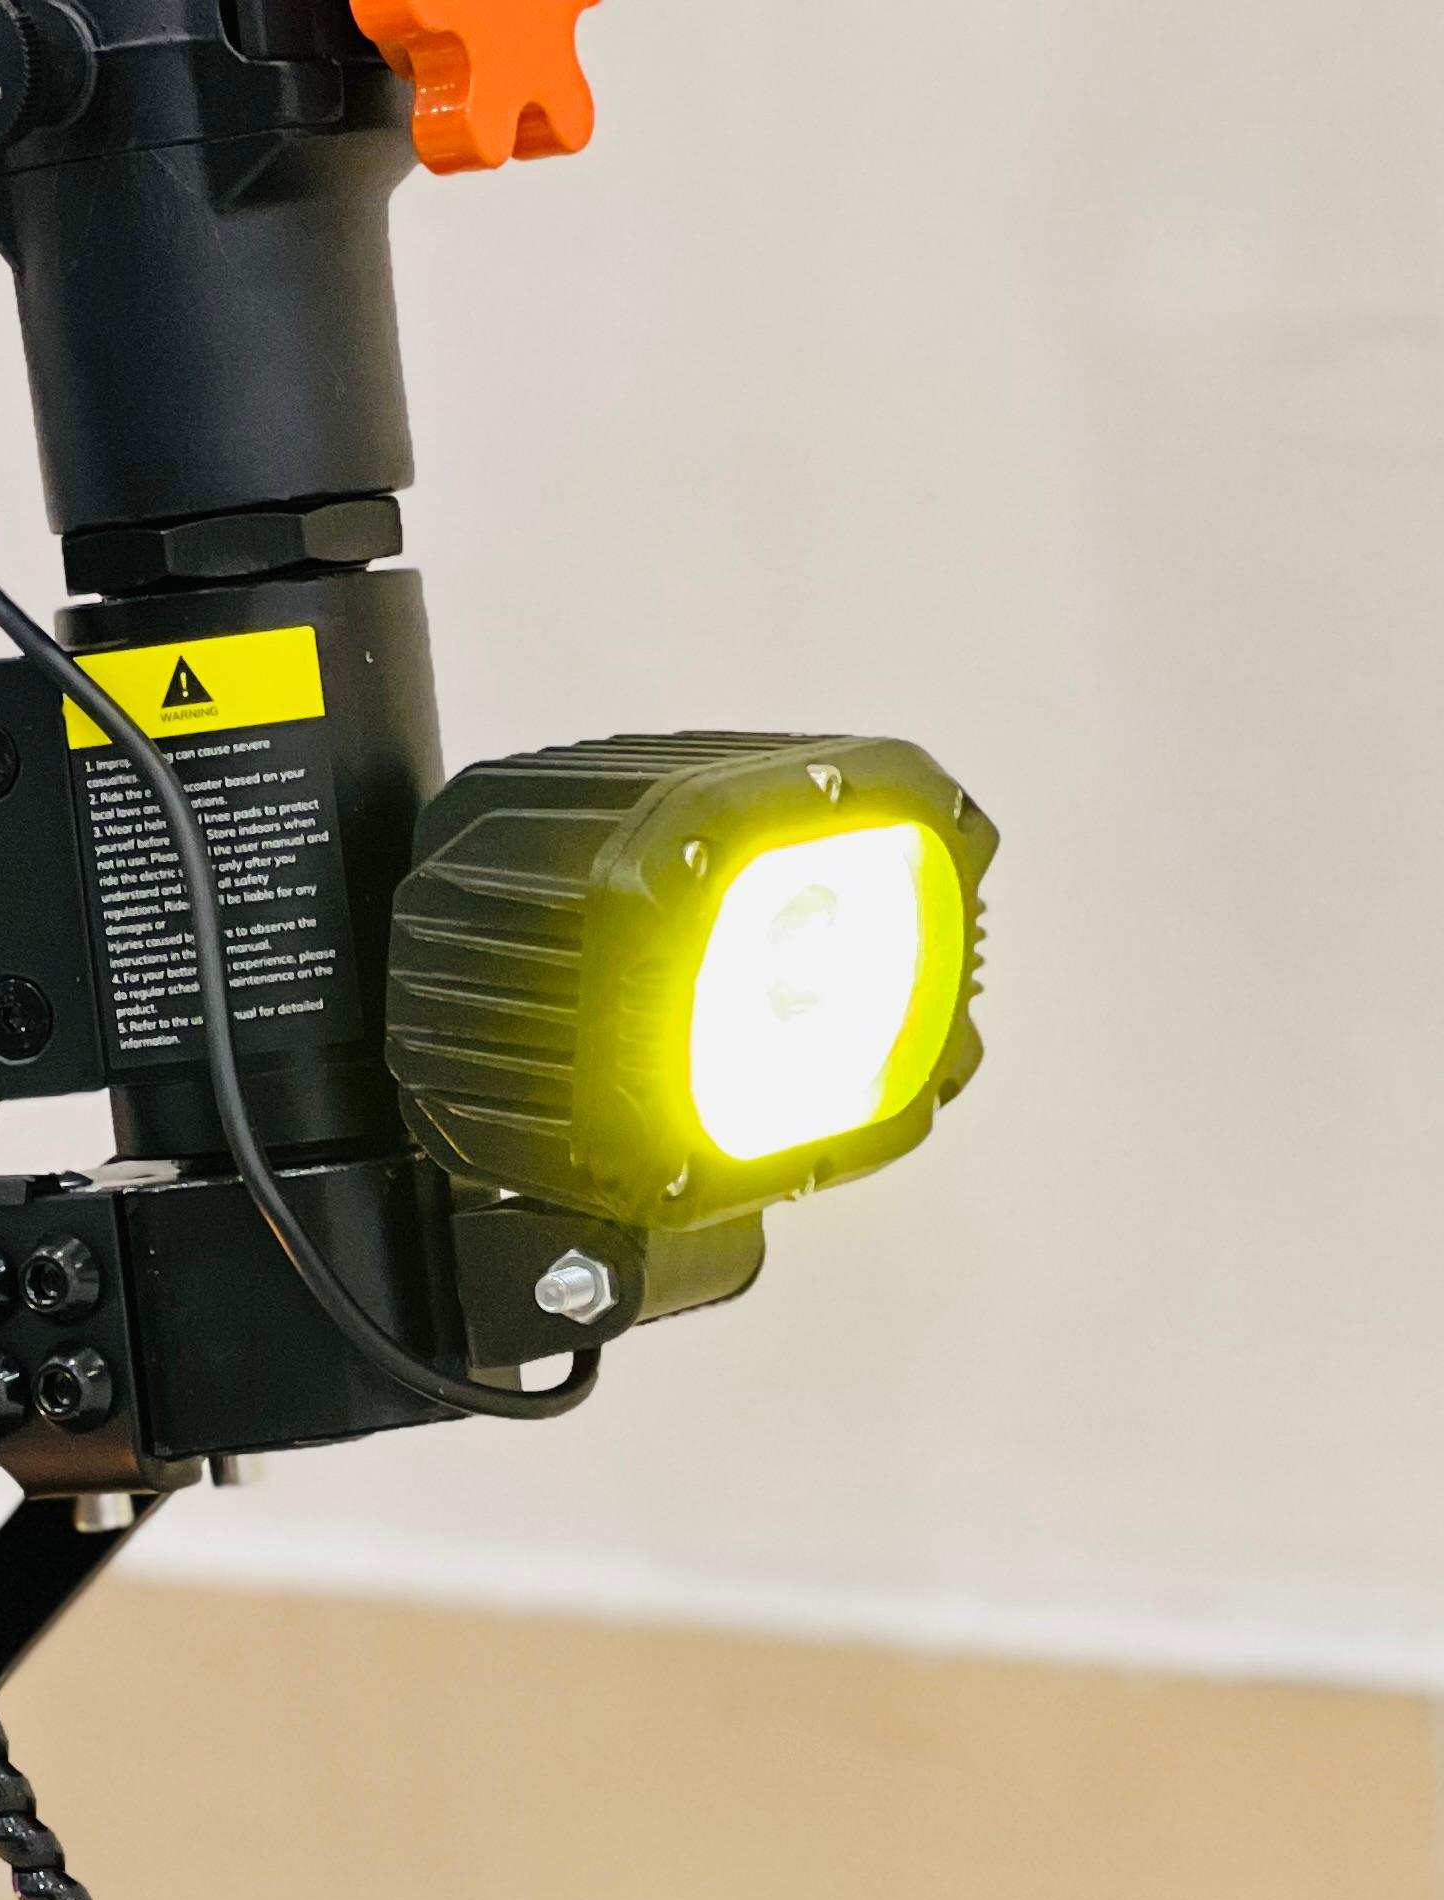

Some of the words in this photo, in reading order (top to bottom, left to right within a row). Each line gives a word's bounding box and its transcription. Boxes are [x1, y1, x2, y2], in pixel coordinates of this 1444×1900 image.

[160, 706, 218, 722] WARNING
[96, 759, 132, 771] Improp
[176, 750, 195, 760] can
[198, 745, 230, 757] cause
[233, 740, 270, 752] severe
[101, 792, 123, 802] Ride
[125, 789, 142, 800] the
[183, 780, 222, 793] scooter
[225, 773, 260, 787] based
[280, 769, 305, 783] your
[91, 808, 114, 820] local
[116, 807, 141, 817] laws
[104, 825, 132, 836] Wear
[205, 812, 231, 823] knee
[234, 806, 262, 822] pads
[279, 800, 319, 815] protect
[95, 839, 134, 856] yourself
[137, 836, 170, 848] before
[207, 829, 236, 840] Store
[239, 822, 281, 835] indoors
[284, 818, 316, 829] when
[97, 860, 114, 870] not
[151, 853, 179, 863] Pleas
[214, 845, 231, 855] the
[234, 842, 257, 853] user
[262, 834, 304, 849] manual
[307, 831, 329, 843] and
[99, 875, 118, 886] ride
[121, 873, 137, 884] the
[139, 870, 175, 881] electric
[219, 860, 242, 872] only
[245, 857, 271, 868] after
[274, 855, 296, 868] you
[101, 886, 159, 903] understand
[161, 883, 181, 895] and
[218, 877, 231, 888] all
[234, 874, 269, 886] safety
[104, 905, 163, 920] regulations.
[244, 889, 274, 901] liable
[277, 887, 293, 897] for
[296, 885, 316, 896] any
[106, 922, 153, 935] damages
[108, 940, 143, 953] injuries
[146, 933, 182, 947] caused
[250, 921, 295, 934] observe
[298, 917, 316, 928] the
[110, 954, 168, 968] instructions
[123, 973, 139, 983] For
[142, 971, 164, 983] your
[167, 967, 197, 978] better
[233, 955, 296, 970] experience,
[299, 949, 335, 964] please
[129, 986, 165, 1000] regular
[314, 966, 333, 976] the
[116, 1004, 158, 1019] product.
[130, 1020, 156, 1032] Refer
[172, 1017, 188, 1027] the
[259, 1006, 275, 1017] for
[278, 998, 323, 1015] detailed
[120, 1035, 180, 1049] information.
